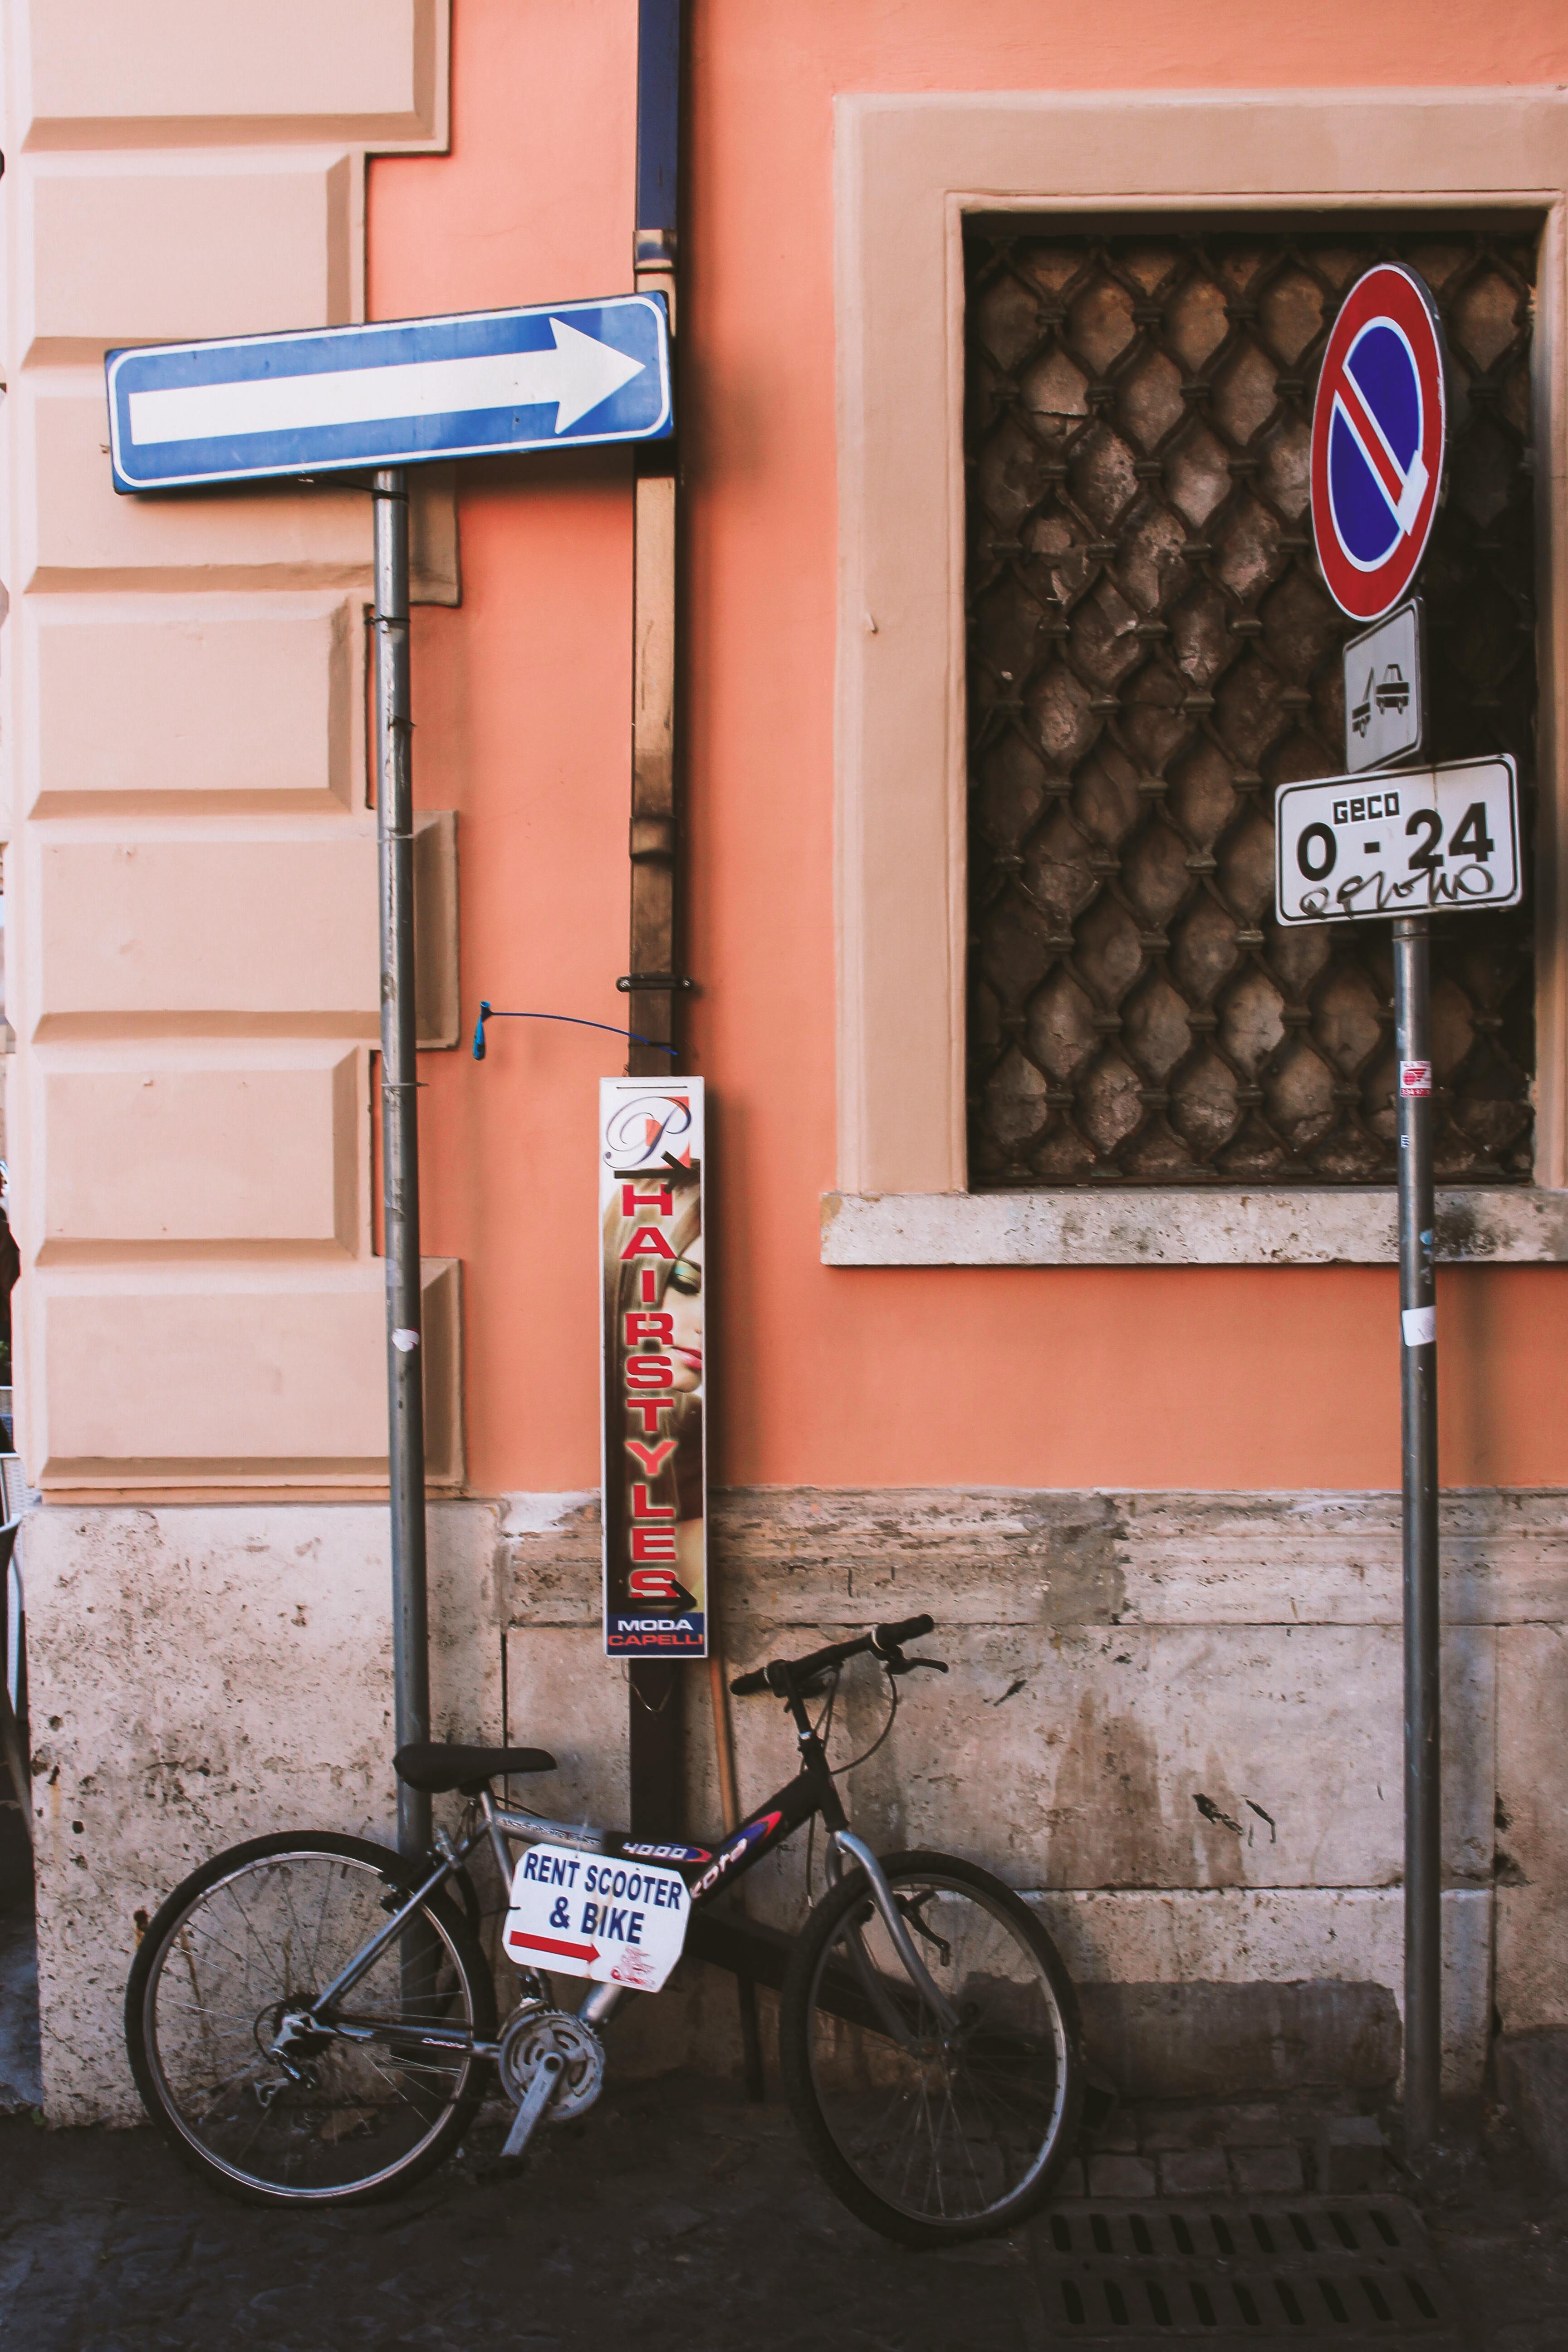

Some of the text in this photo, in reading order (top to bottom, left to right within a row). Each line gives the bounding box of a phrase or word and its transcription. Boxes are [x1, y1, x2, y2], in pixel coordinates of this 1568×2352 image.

[1297, 822, 1338, 882] 0
[1405, 801, 1495, 870] 24
[620, 1183, 680, 1599] HAIRSTYLES
[608, 1633, 703, 1646] CAPELLI
[617, 1619, 694, 1632] MODA
[622, 1842, 688, 1859] 4000
[523, 1852, 682, 1910] RENT SCOOTER
[549, 1896, 645, 1944] & BIKE
